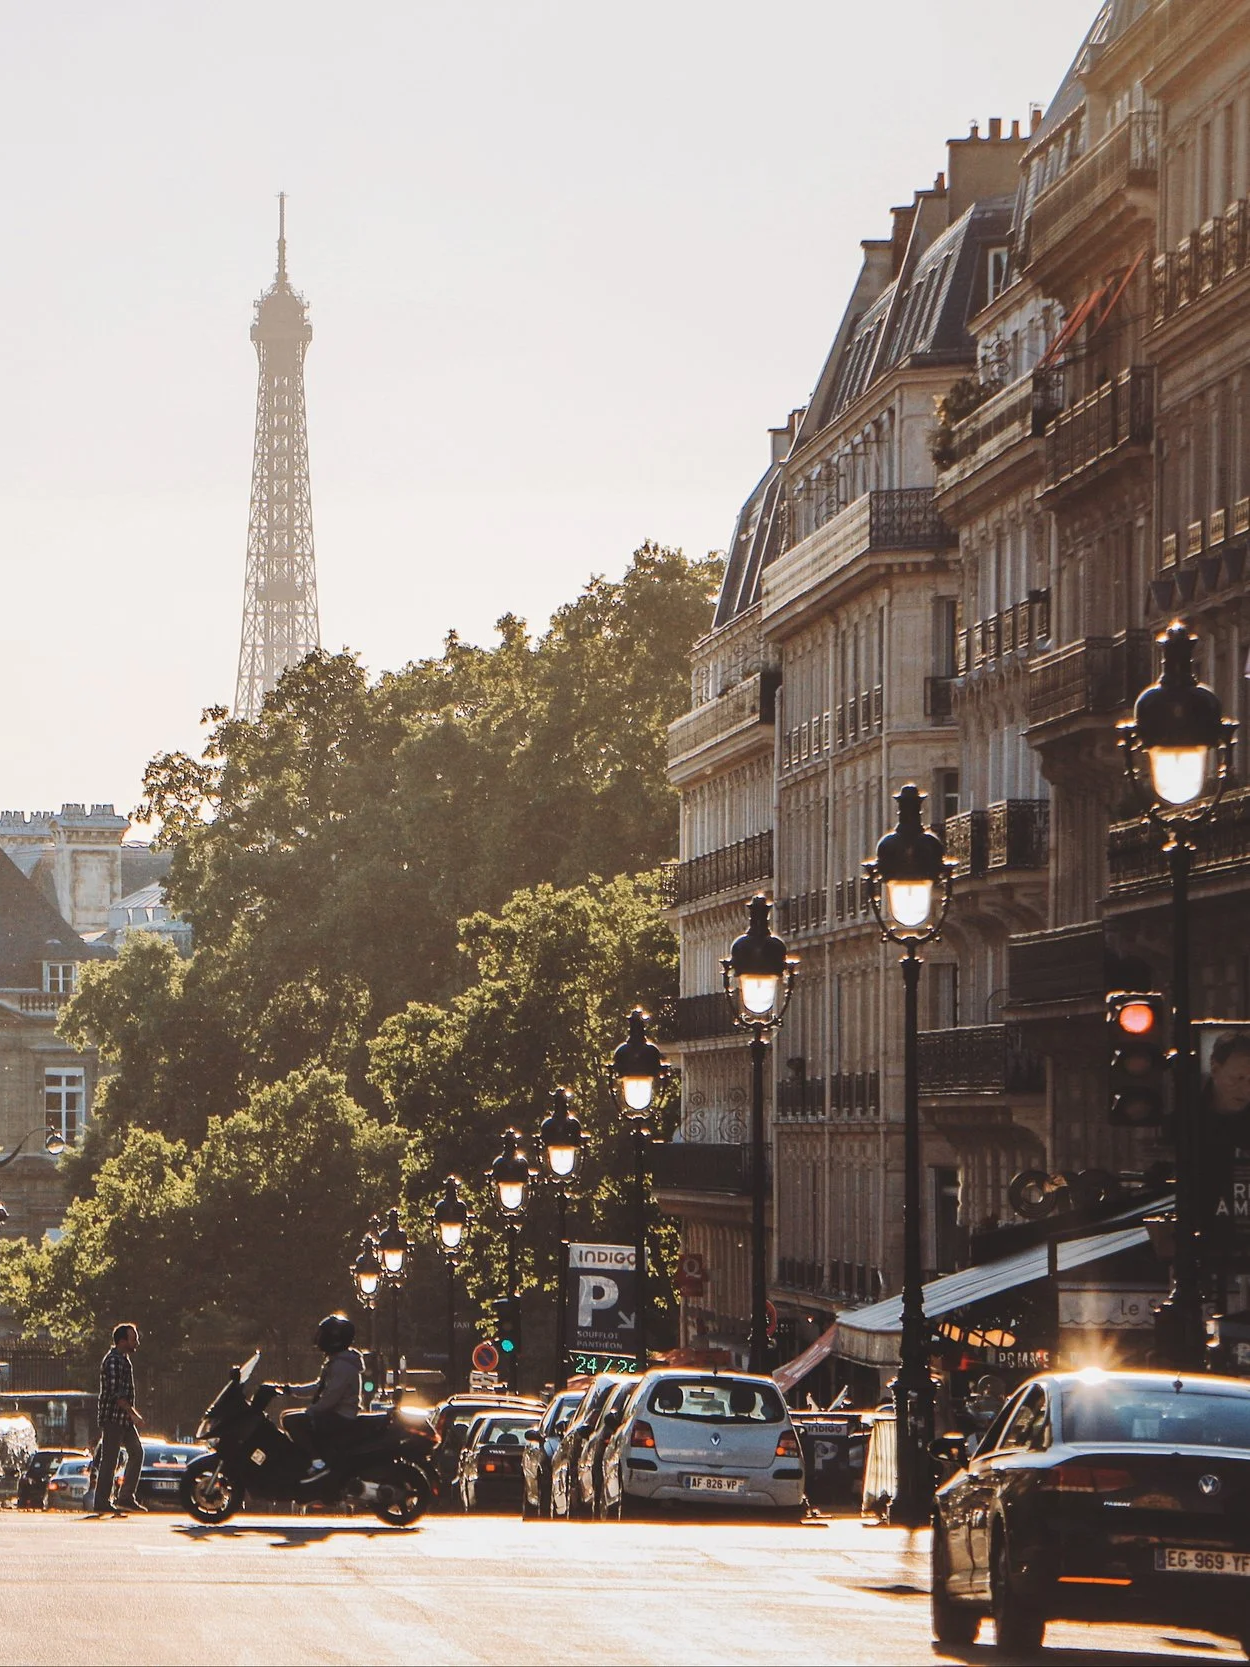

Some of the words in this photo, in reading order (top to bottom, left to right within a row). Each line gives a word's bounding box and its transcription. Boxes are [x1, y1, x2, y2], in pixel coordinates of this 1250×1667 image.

[578, 1275, 619, 1327] P
[577, 1330, 619, 1340] SOUFFLOT
[692, 1477, 738, 1491] AF-826-VP
